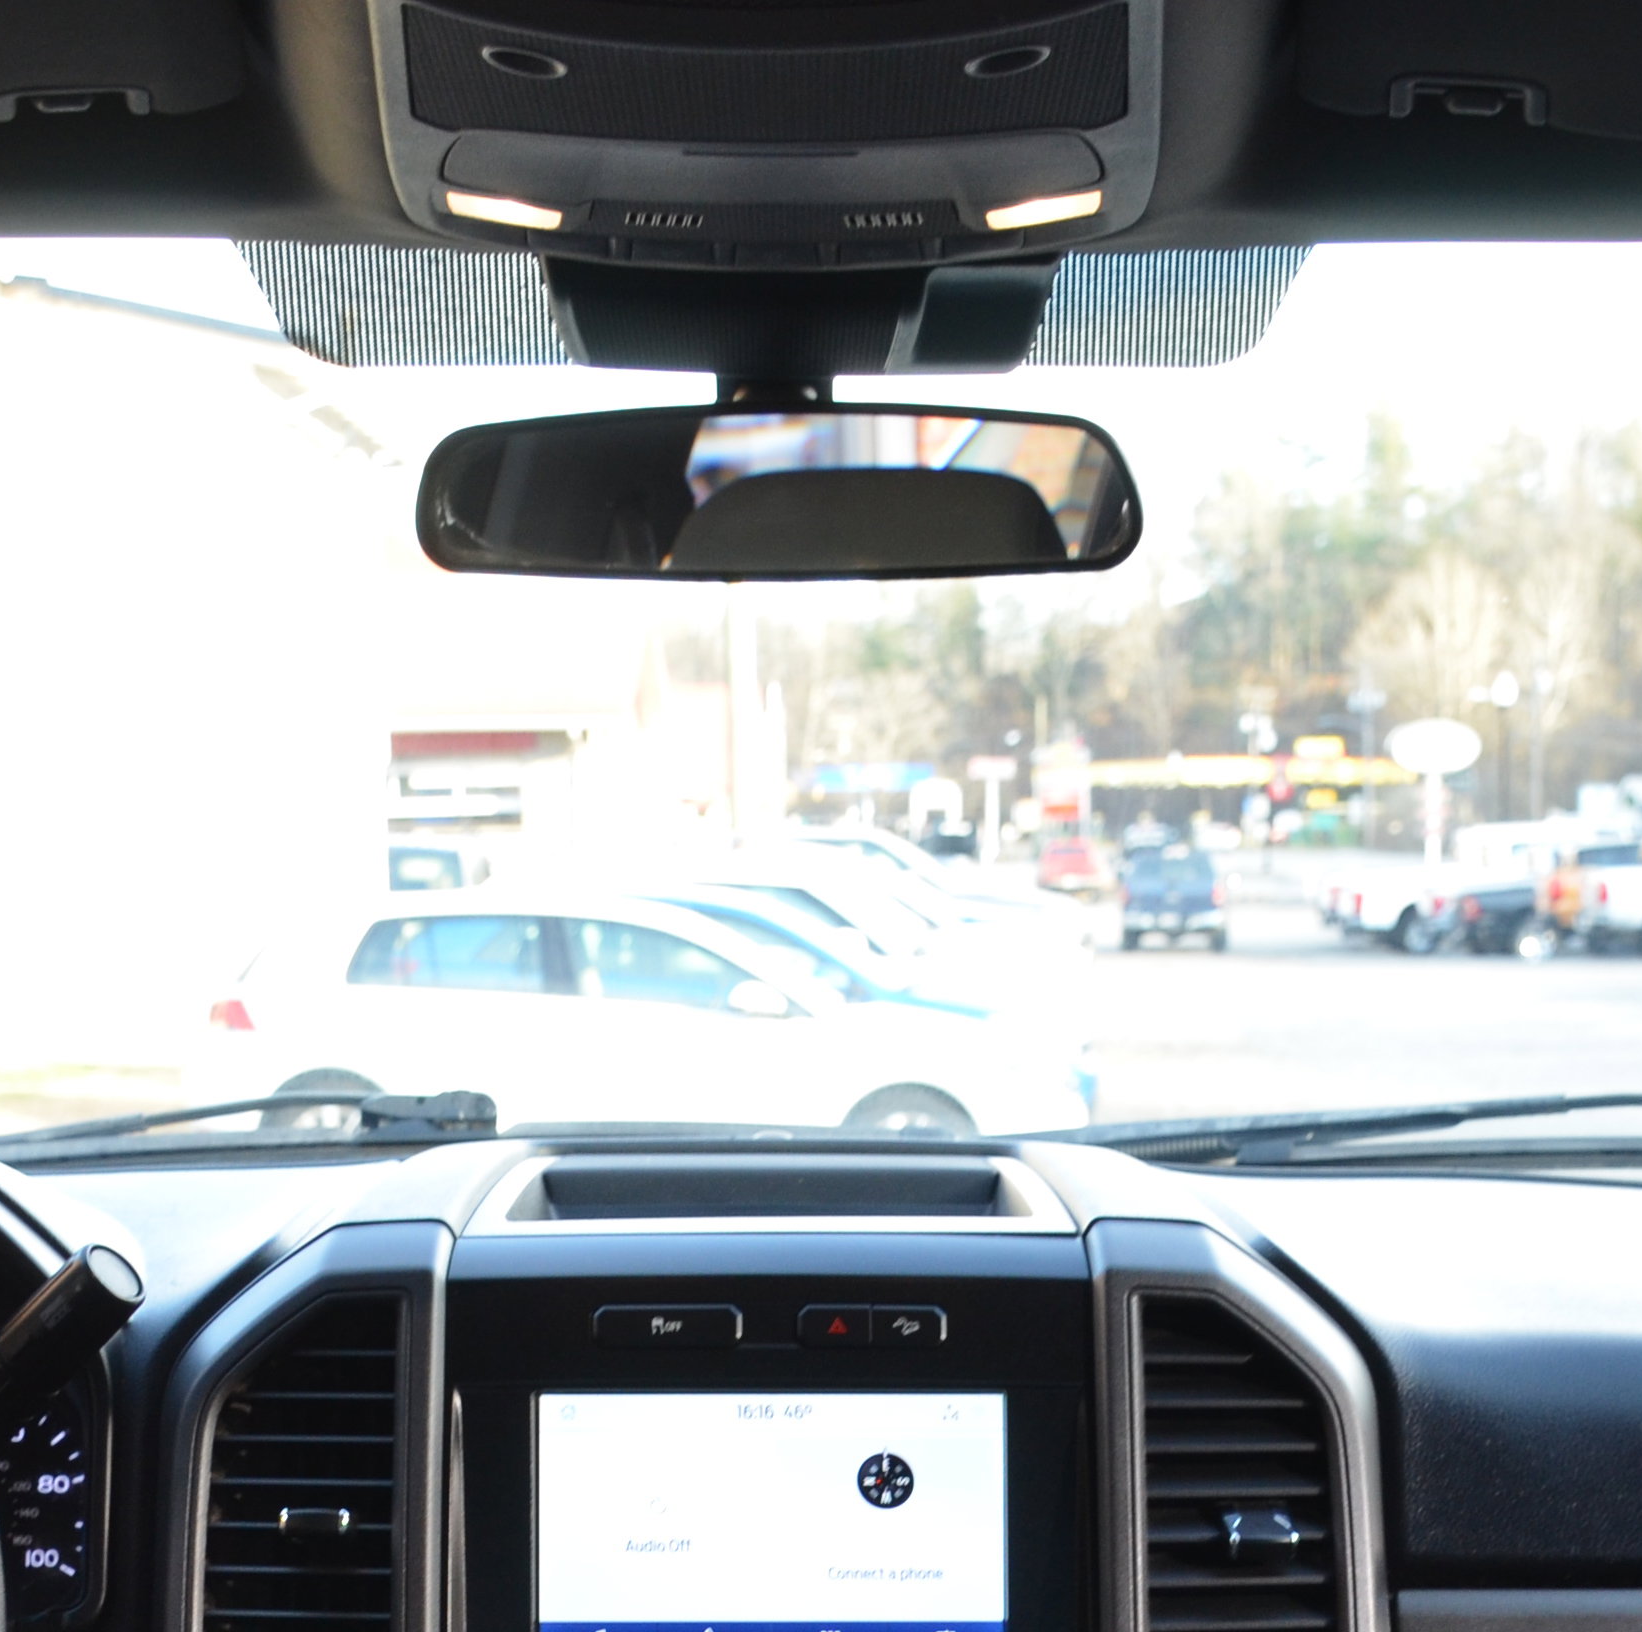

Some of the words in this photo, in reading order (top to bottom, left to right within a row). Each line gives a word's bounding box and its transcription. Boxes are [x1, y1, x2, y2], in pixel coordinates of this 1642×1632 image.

[737, 1403, 775, 1420] 16:16
[36, 1473, 71, 1495] 80
[625, 1538, 666, 1553] Audio
[668, 1538, 692, 1553] Off
[23, 1547, 60, 1569] 100
[827, 1565, 885, 1581] Connect
[899, 1565, 945, 1582] phone
